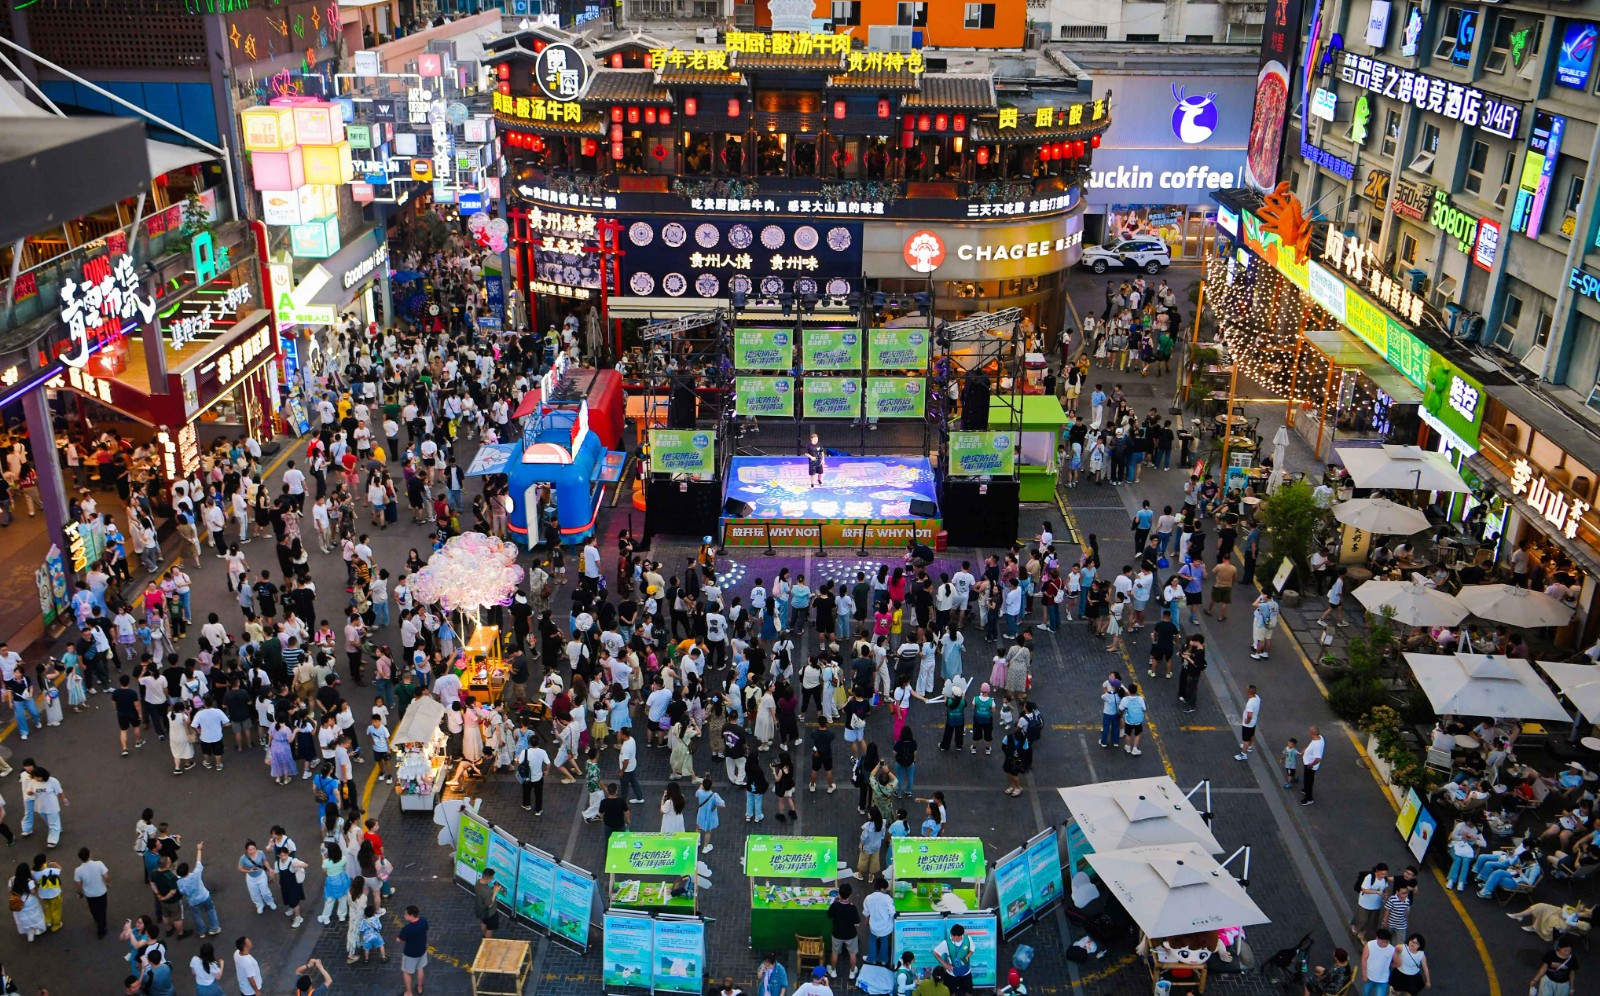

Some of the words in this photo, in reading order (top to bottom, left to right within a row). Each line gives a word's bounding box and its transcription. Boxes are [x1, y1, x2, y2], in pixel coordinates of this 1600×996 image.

[1370, 17, 1385, 31] intel
[772, 32, 851, 54] 酸汤牛肉
[649, 48, 729, 71] 百年老酸
[846, 49, 925, 74] 贵州特色
[1159, 165, 1234, 189] coffee
[1364, 170, 1389, 199] 2K
[528, 206, 597, 235] 贵州烧烤
[957, 240, 1051, 261] CHAGEE
[690, 252, 753, 269] 贵州人情
[770, 255, 819, 271] 贵州味
[278, 293, 295, 310] A
[295, 314, 330, 322] 电梯入口
[1511, 459, 1569, 531] 李山山
[732, 528, 764, 537] 放开玩
[768, 528, 793, 537] WHY
[876, 529, 902, 538] WHY
[903, 529, 932, 538] NOT!
[629, 851, 672, 860] 地灾防治
[769, 853, 813, 864] 地灾防治
[917, 853, 960, 865] 地灾防治
